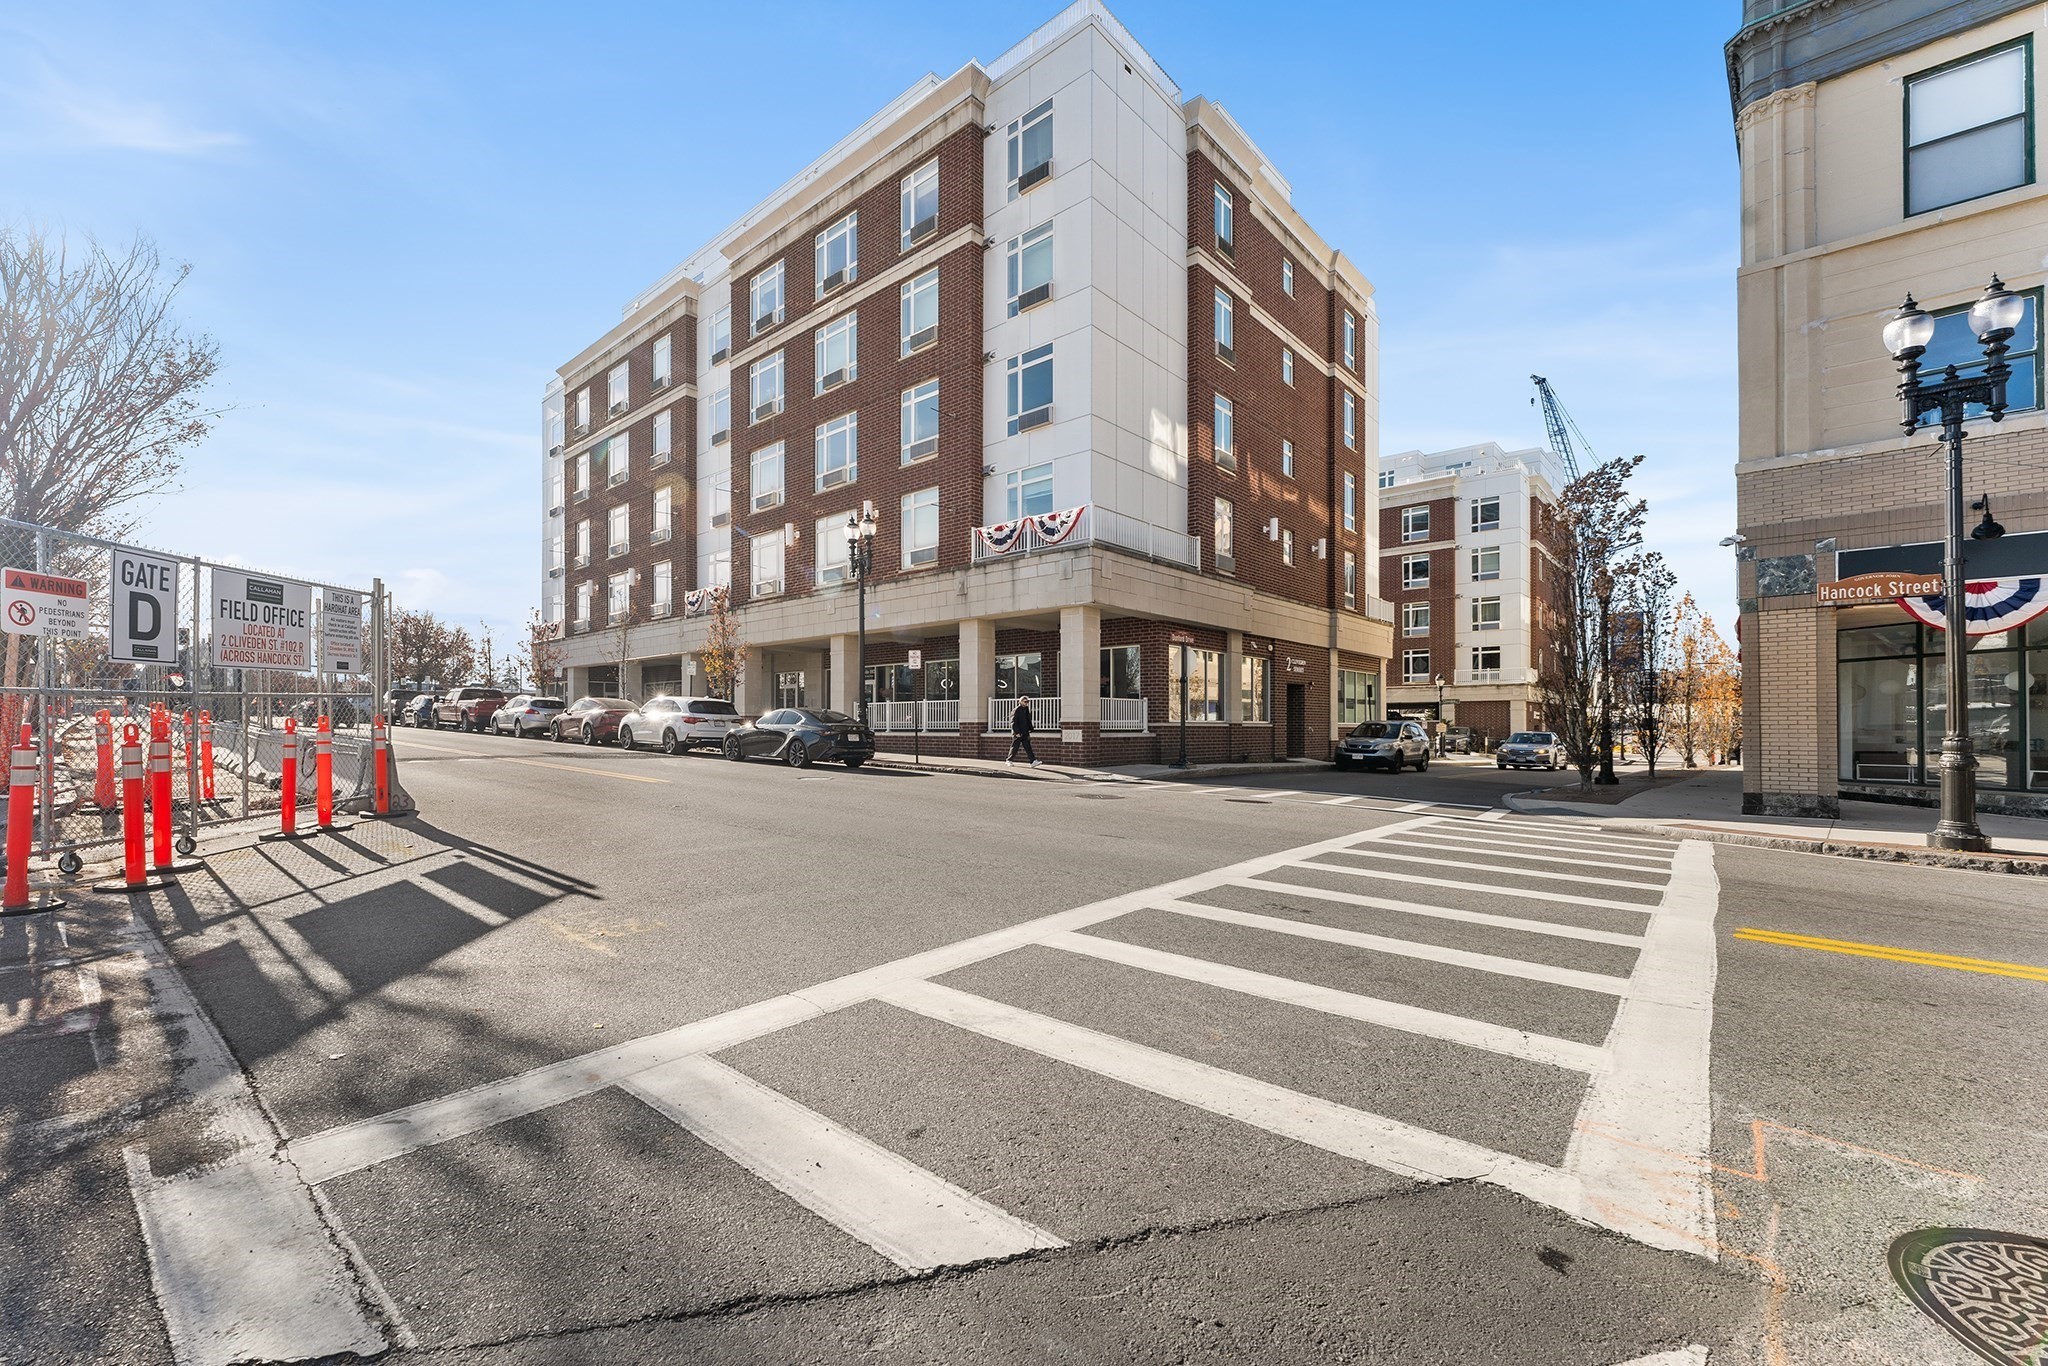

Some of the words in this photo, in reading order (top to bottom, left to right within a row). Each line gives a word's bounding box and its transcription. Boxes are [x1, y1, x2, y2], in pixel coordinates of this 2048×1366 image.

[121, 559, 170, 592] GATE
[1854, 574, 1884, 582] GOVERNOR
[30, 577, 83, 596] WARNING
[248, 585, 282, 595] CALLAHAN
[1820, 583, 1882, 600] Hancock
[1888, 578, 1938, 596] Street
[57, 599, 68, 607] NO
[332, 592, 344, 603] THIS
[344, 594, 350, 605] IS
[350, 596, 355, 605] A
[38, 606, 85, 619] PEDESTRIANS
[128, 591, 161, 641] D
[220, 599, 258, 622] FIELD
[263, 605, 305, 628] OFFICE
[324, 602, 347, 615] HARDHAT
[347, 606, 361, 617] AREA
[48, 618, 76, 628] BEYOND
[42, 627, 58, 636] THIS
[61, 629, 82, 638] POINT
[243, 623, 276, 638] LOCATED
[277, 627, 286, 639] AT
[221, 634, 227, 646] 2
[228, 635, 267, 650] CLIVEDEN
[268, 639, 278, 651] ST.
[280, 640, 297, 653] #102
[298, 641, 304, 653] R
[220, 649, 255, 663] (ACROSS
[257, 652, 292, 666] HANCOCK
[293, 654, 305, 667] ST.)
[1286, 656, 1291, 671] 2
